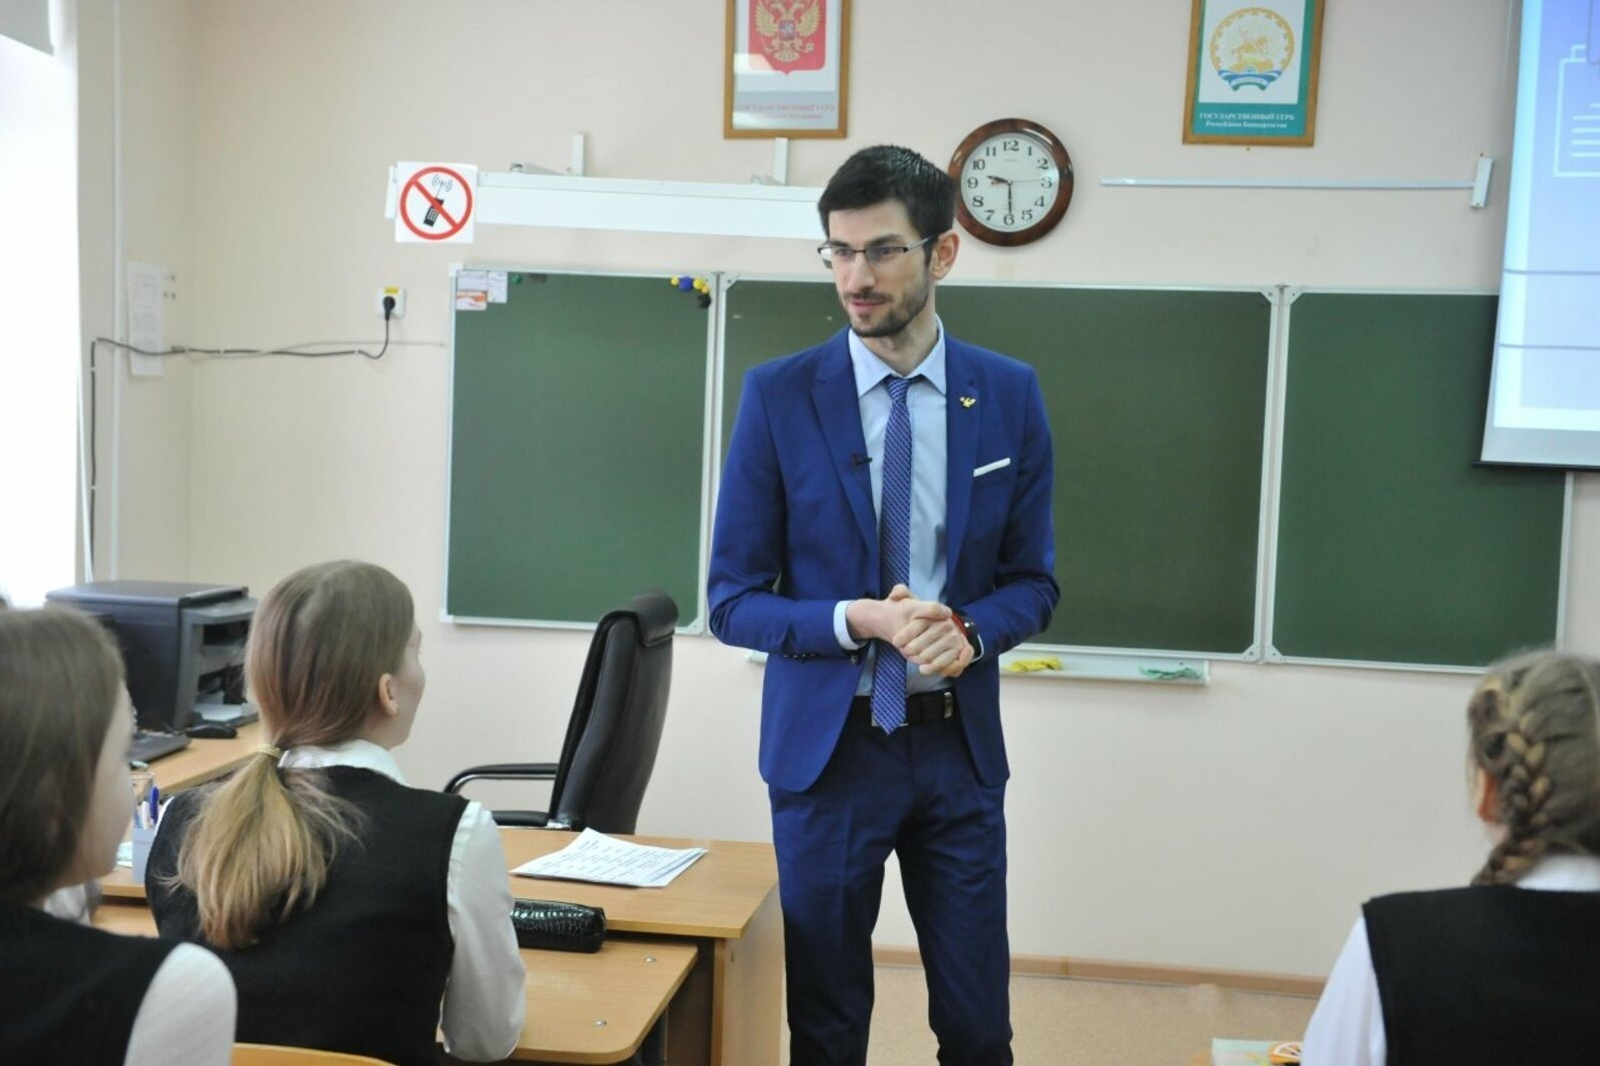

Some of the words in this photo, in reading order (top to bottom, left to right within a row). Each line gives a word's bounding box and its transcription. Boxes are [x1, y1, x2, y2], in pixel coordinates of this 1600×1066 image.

[1199, 112, 1275, 120] ГОСУДАРСТВЕННЫЙ
[1276, 113, 1295, 121] ГЕРБ
[985, 146, 996, 156] 11
[1003, 140, 1019, 151] 12
[972, 159, 985, 170] 10
[1037, 158, 1049, 170] 2
[967, 177, 978, 189] 9
[1041, 177, 1053, 188] 3
[972, 195, 984, 207] 8
[1034, 195, 1045, 207] 4
[984, 209, 995, 221] 7
[1003, 213, 1015, 226] 6
[1021, 209, 1033, 220] 5
